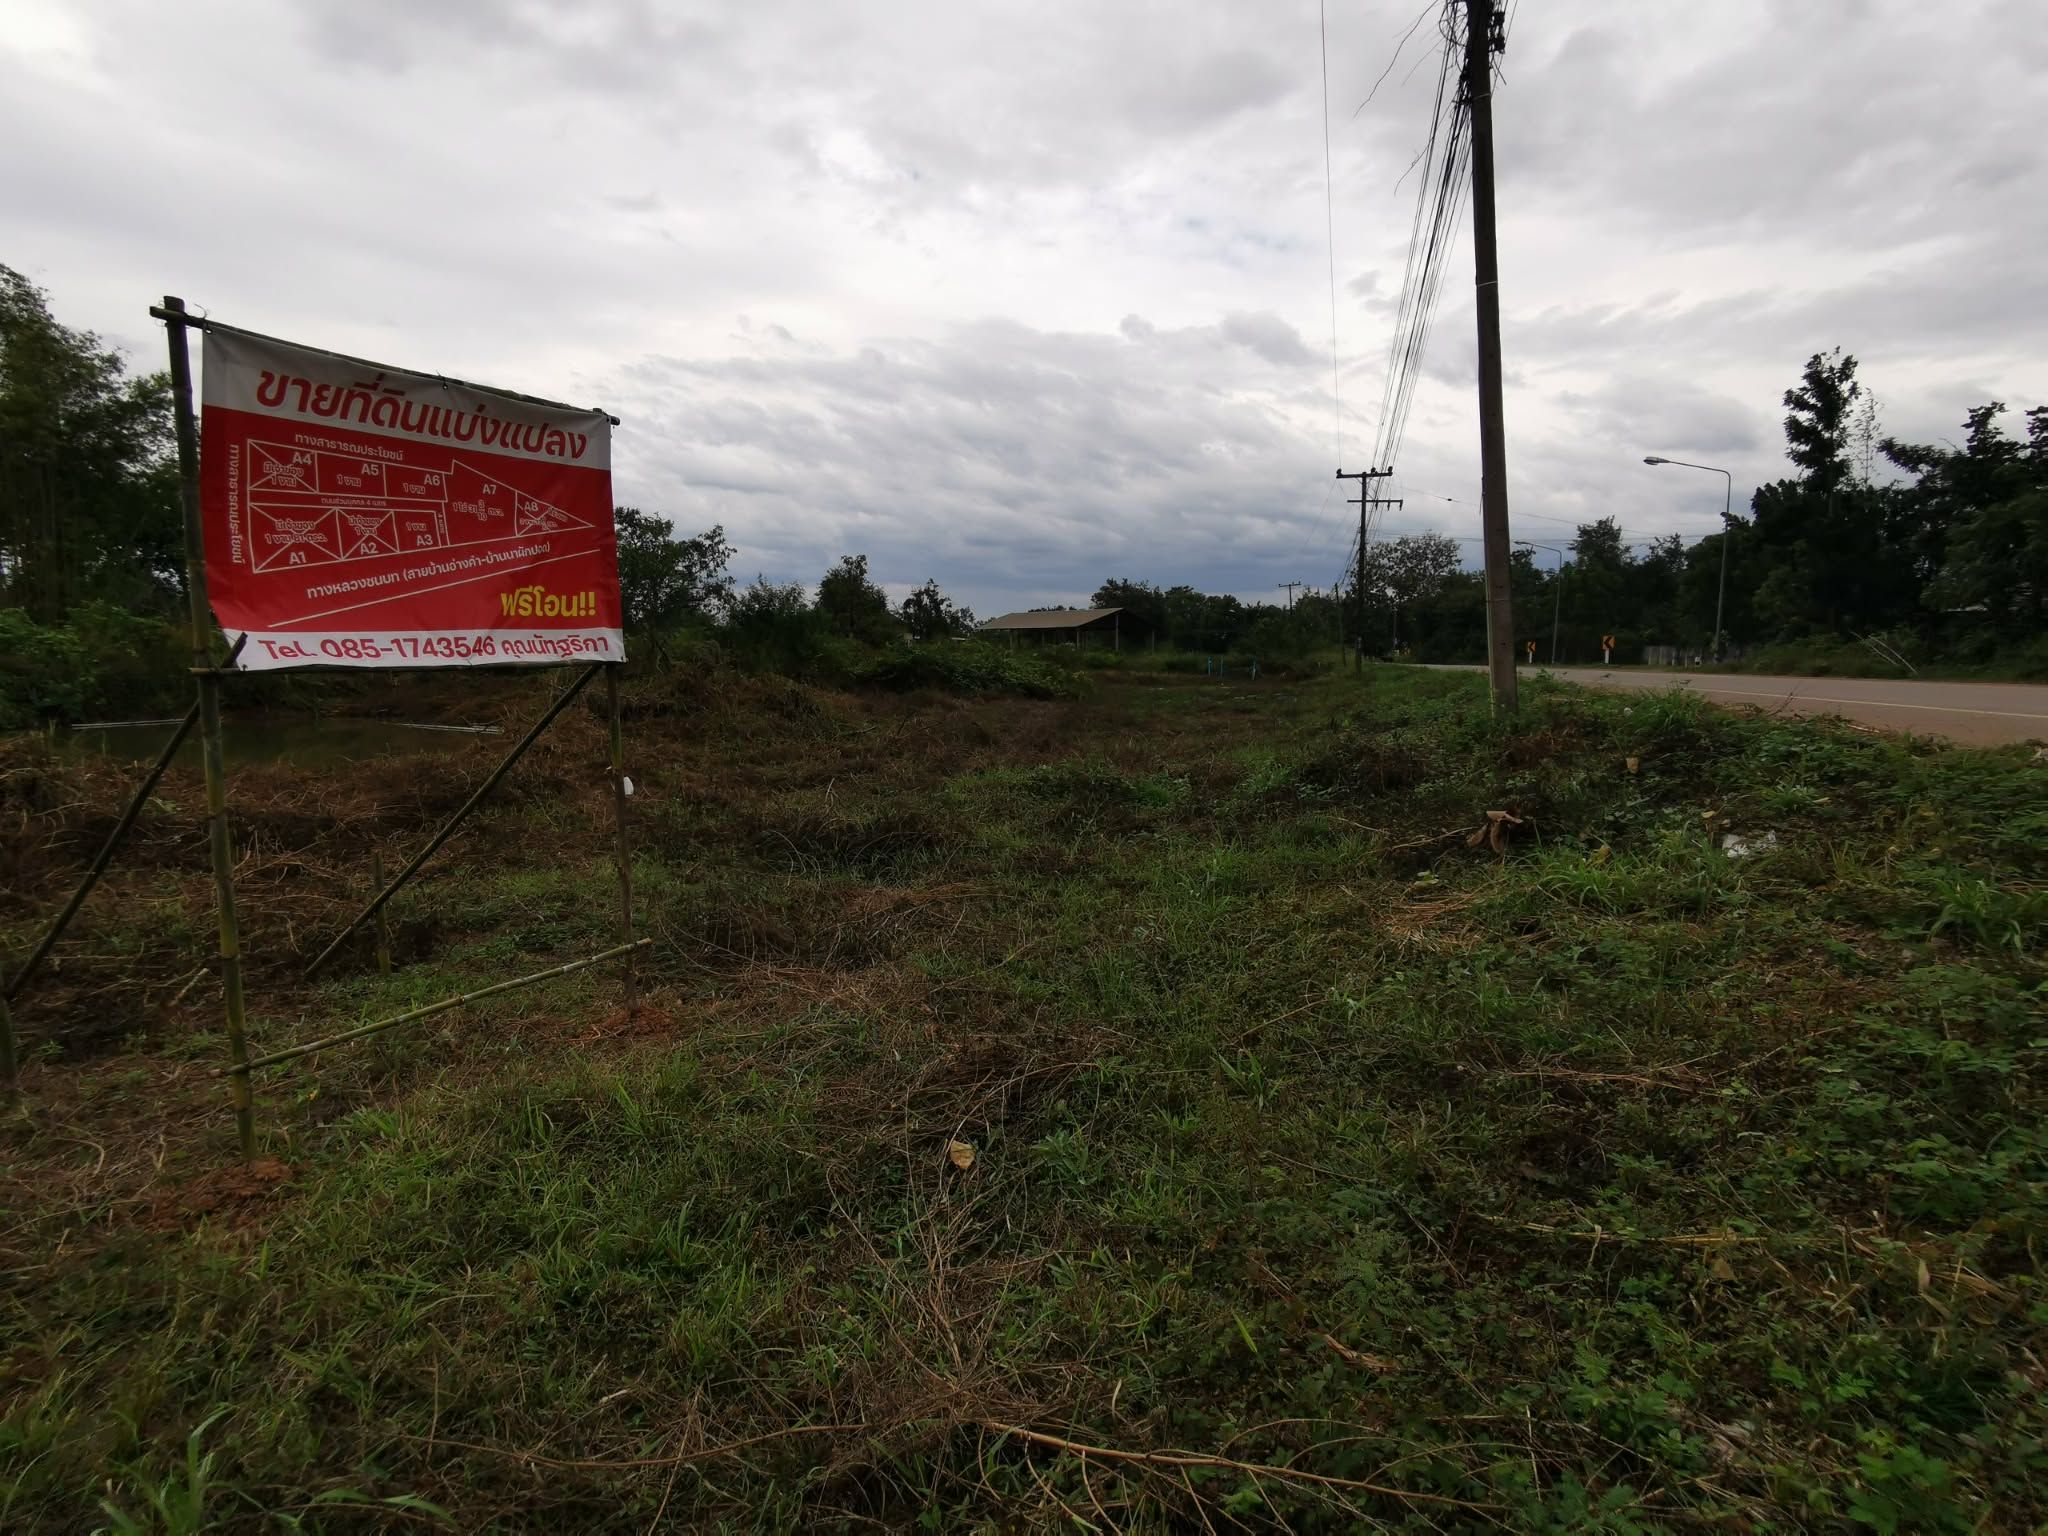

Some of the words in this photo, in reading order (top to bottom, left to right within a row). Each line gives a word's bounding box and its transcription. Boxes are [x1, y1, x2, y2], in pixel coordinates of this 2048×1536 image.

[256, 369, 587, 459] ขายที่ดินแบ่งแปลง
[292, 452, 312, 465] A4
[361, 463, 379, 476] A5
[423, 474, 441, 486] A6
[482, 483, 497, 495] A7
[524, 501, 539, 512] A8
[416, 534, 434, 547] A3
[360, 542, 379, 555] A2
[288, 552, 308, 565] A1
[307, 572, 400, 599] ทางหลวงชนบท
[500, 585, 597, 617] ฟรีโอน!!
[258, 640, 318, 660] Tel.
[320, 636, 497, 660] 085-1743546
